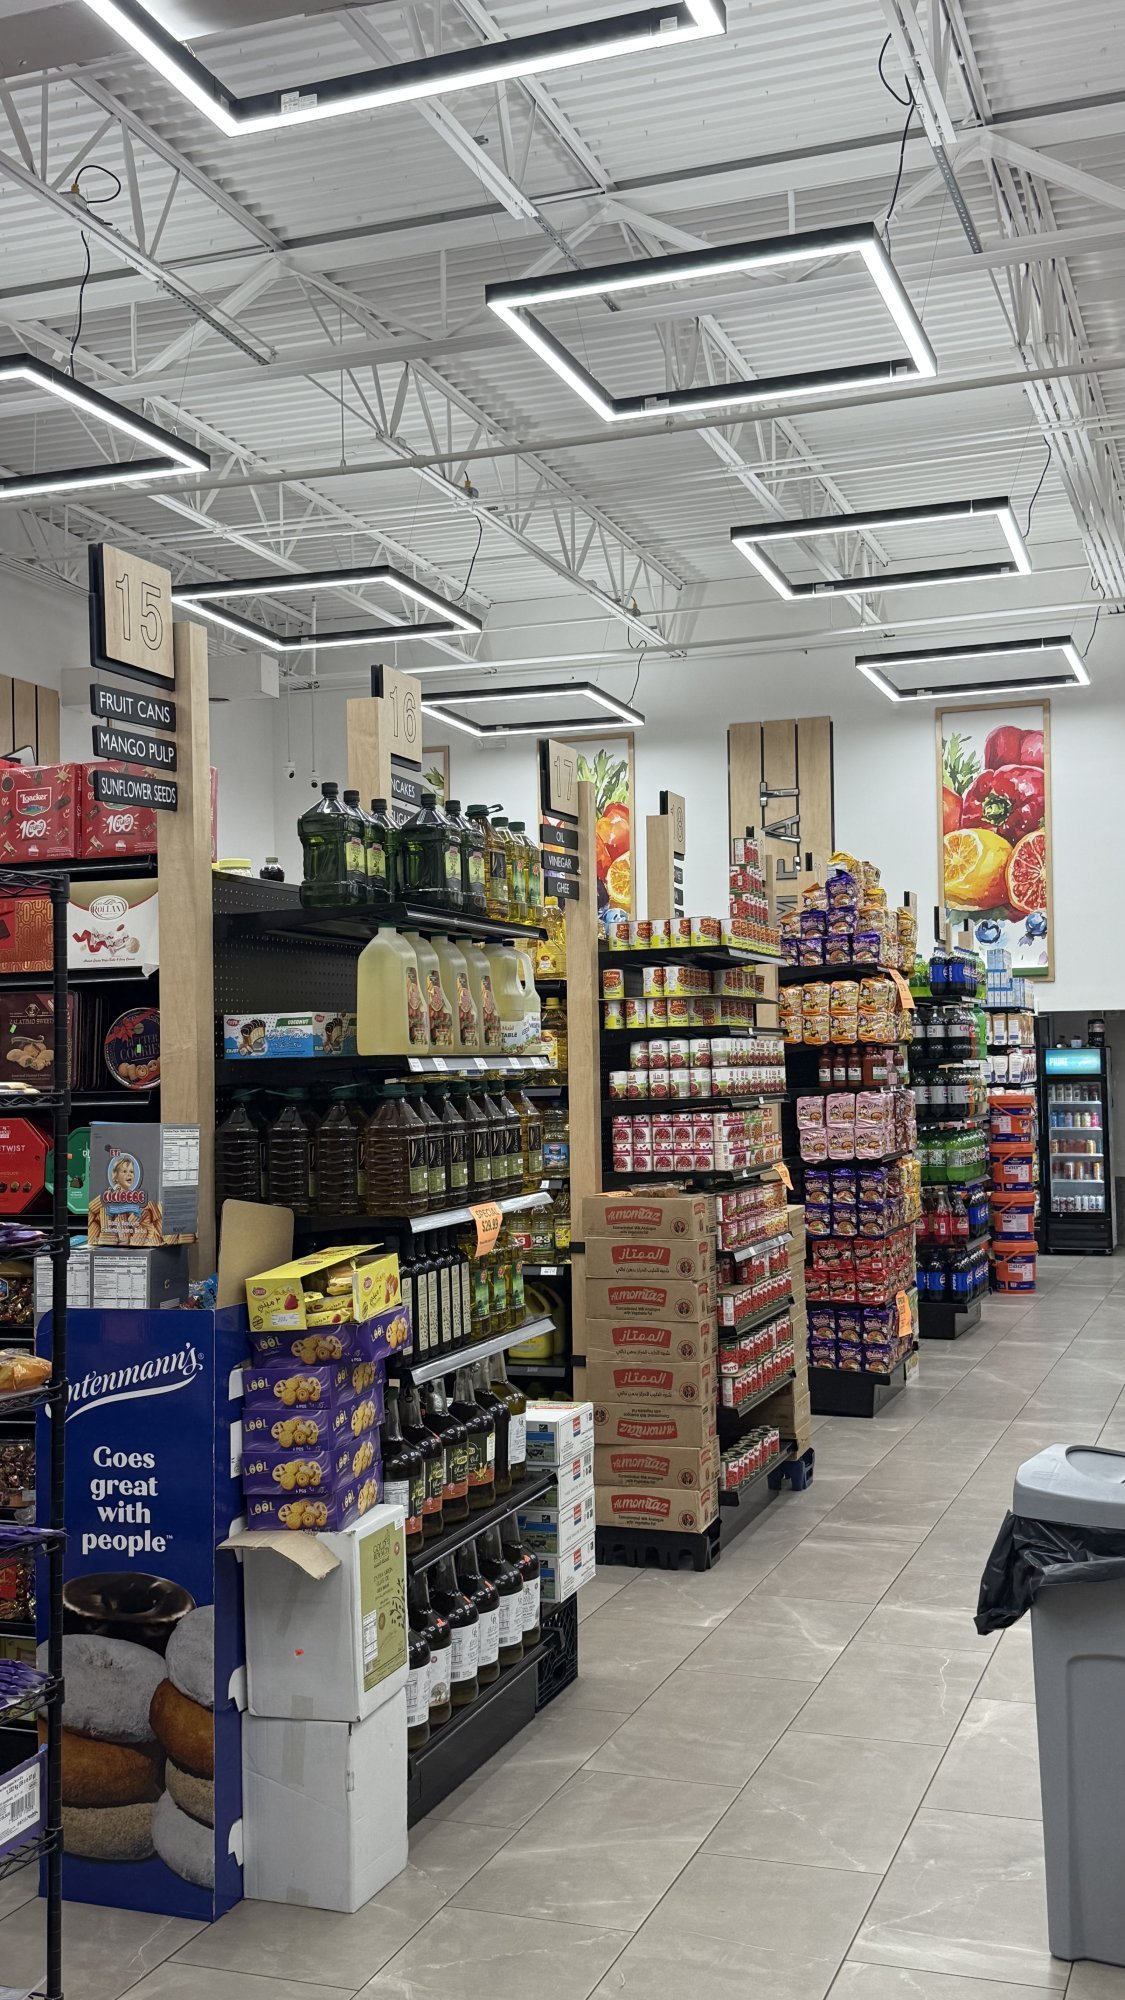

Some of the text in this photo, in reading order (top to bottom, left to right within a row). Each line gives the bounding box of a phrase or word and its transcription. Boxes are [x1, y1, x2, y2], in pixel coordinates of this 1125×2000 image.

[115, 573, 164, 651] 15
[100, 691, 171, 723] FRUIT CANS
[390, 686, 417, 743] 16
[100, 732, 175, 764] MANGO PULP
[554, 756, 574, 800] 17
[20, 793, 48, 804] Loacker
[101, 777, 176, 804] SUNFLOWER SEEDS
[20, 819, 47, 839] 100
[556, 832, 565, 844] OIL
[549, 854, 572, 870] VINEGAR
[557, 882, 570, 895] GHEE
[475, 1207, 500, 1219] SPECIAL
[619, 1248, 664, 1260] الممتاز
[619, 1329, 665, 1342] الممتاز
[60, 1342, 204, 1404] ntenmann's
[621, 1371, 667, 1384] الممتاز
[93, 1446, 155, 1469] Goes
[90, 1476, 159, 1500] great
[97, 1500, 151, 1524] with
